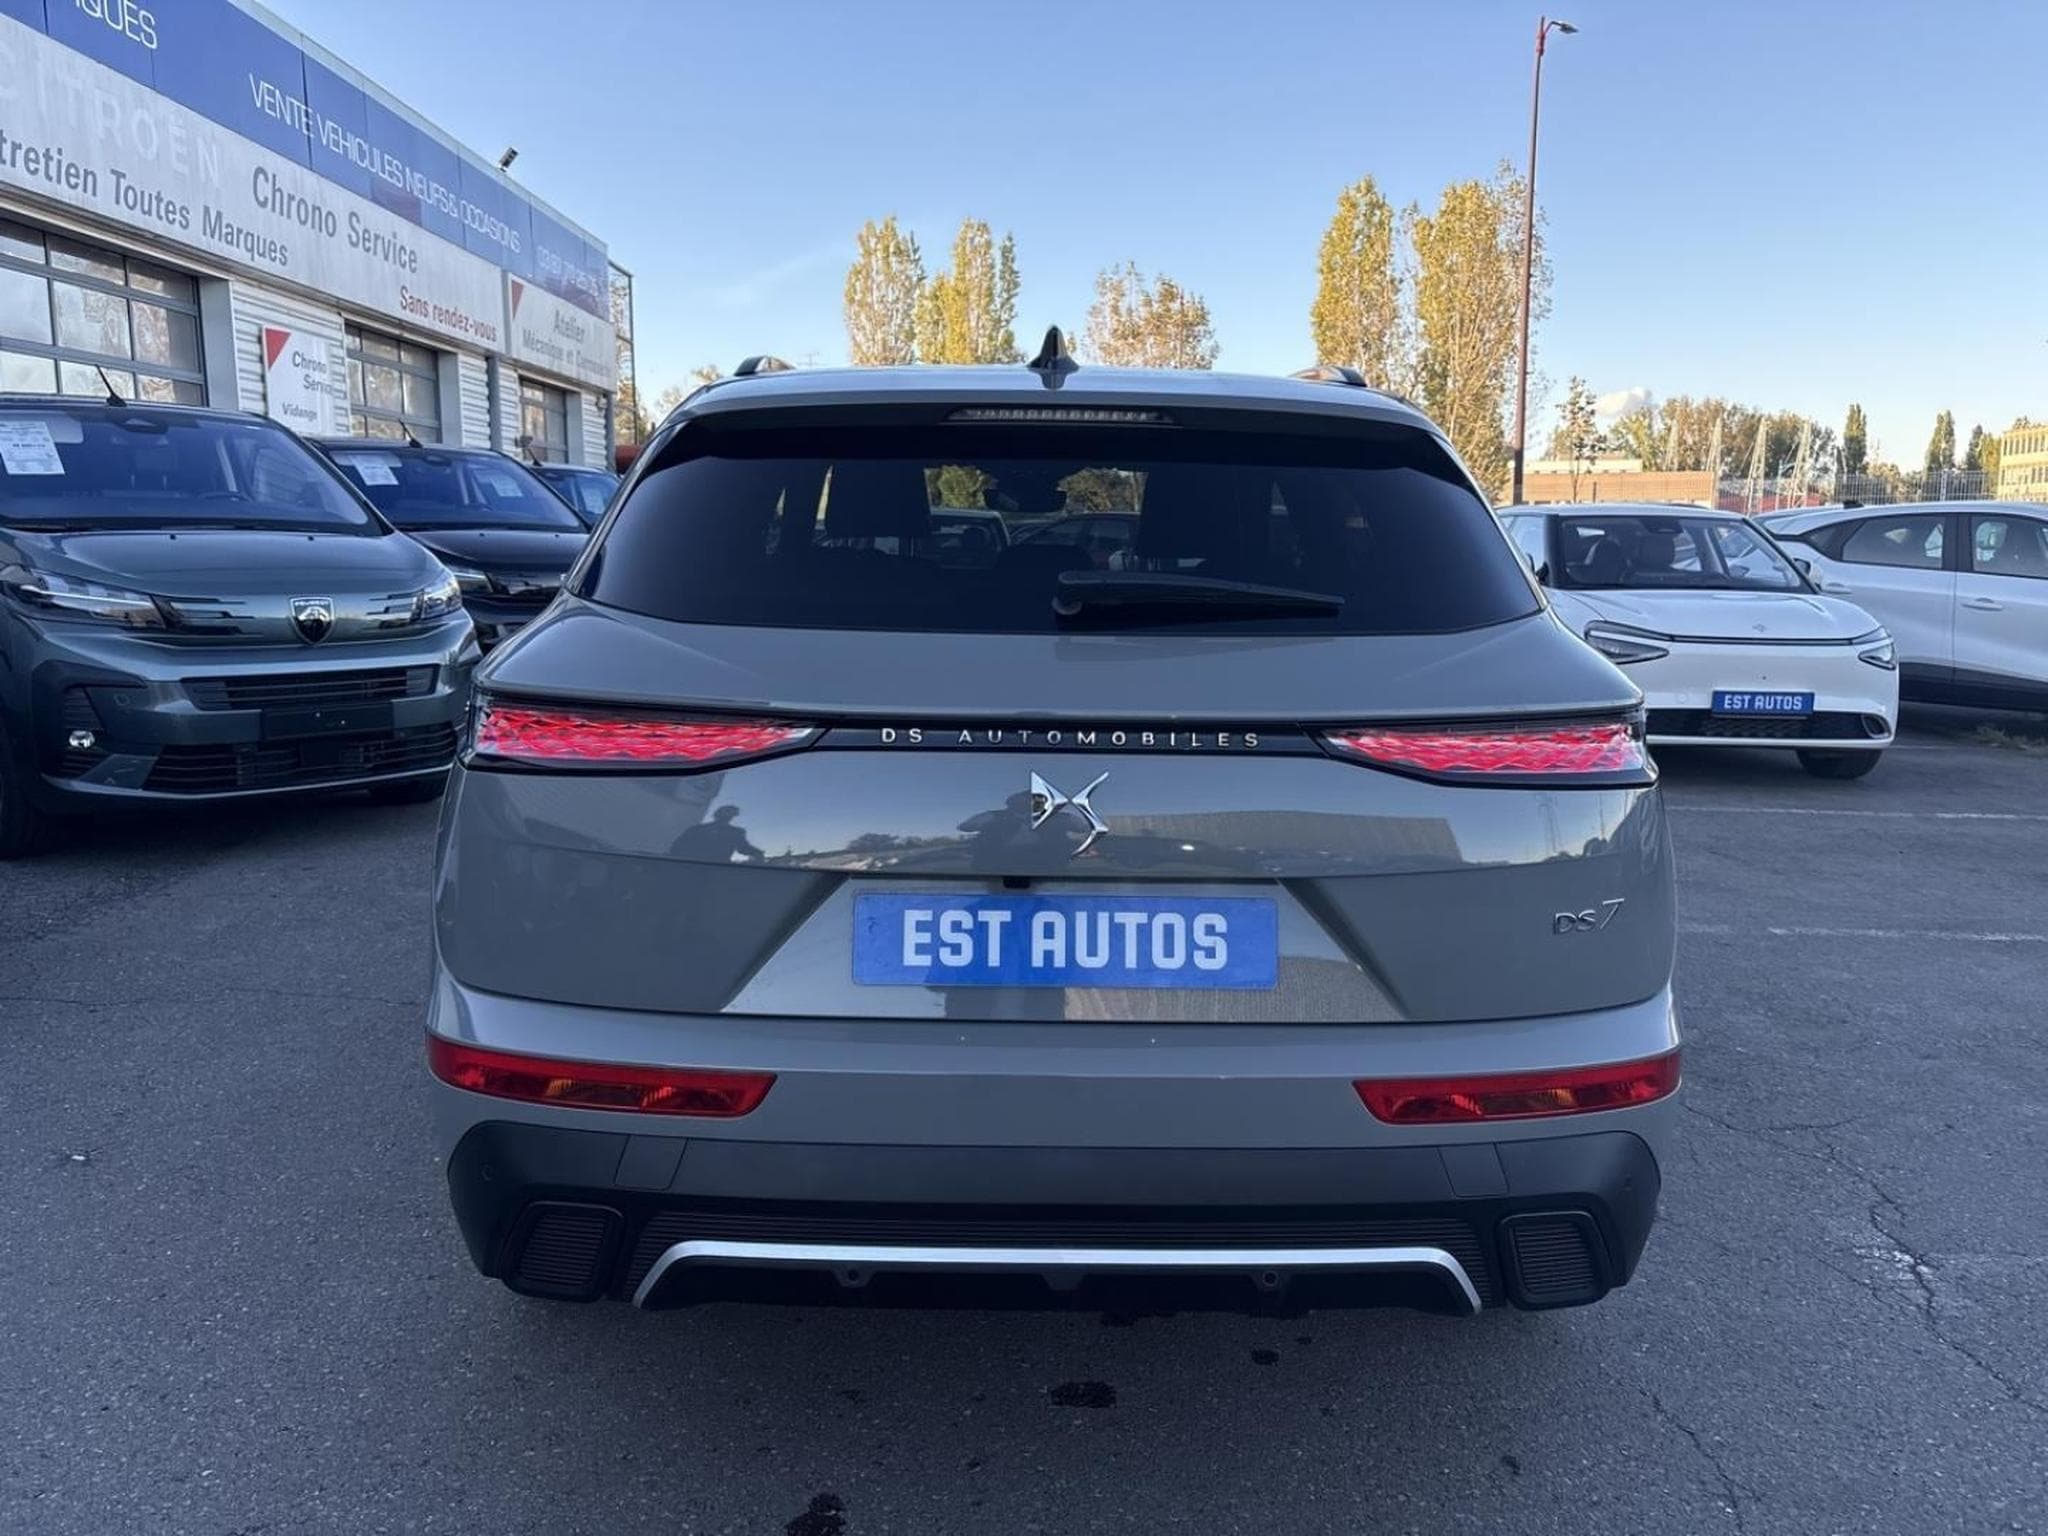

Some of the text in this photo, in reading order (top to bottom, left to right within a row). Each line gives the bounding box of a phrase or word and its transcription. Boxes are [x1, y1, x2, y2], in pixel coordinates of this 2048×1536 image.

[75, 0, 158, 49] QUES
[249, 73, 314, 138] VENTE
[316, 112, 404, 189] VEHICULES
[110, 168, 191, 231] Toutes
[202, 204, 288, 267] Marques
[252, 166, 418, 274] Chrono Service
[400, 286, 498, 342] Sans rendez-vous
[291, 350, 328, 375] Chrono
[1723, 694, 1803, 710] EST AUTOS
[881, 727, 1260, 748] DS AUTOMOBILES
[902, 908, 1229, 971] EST AUTOS
